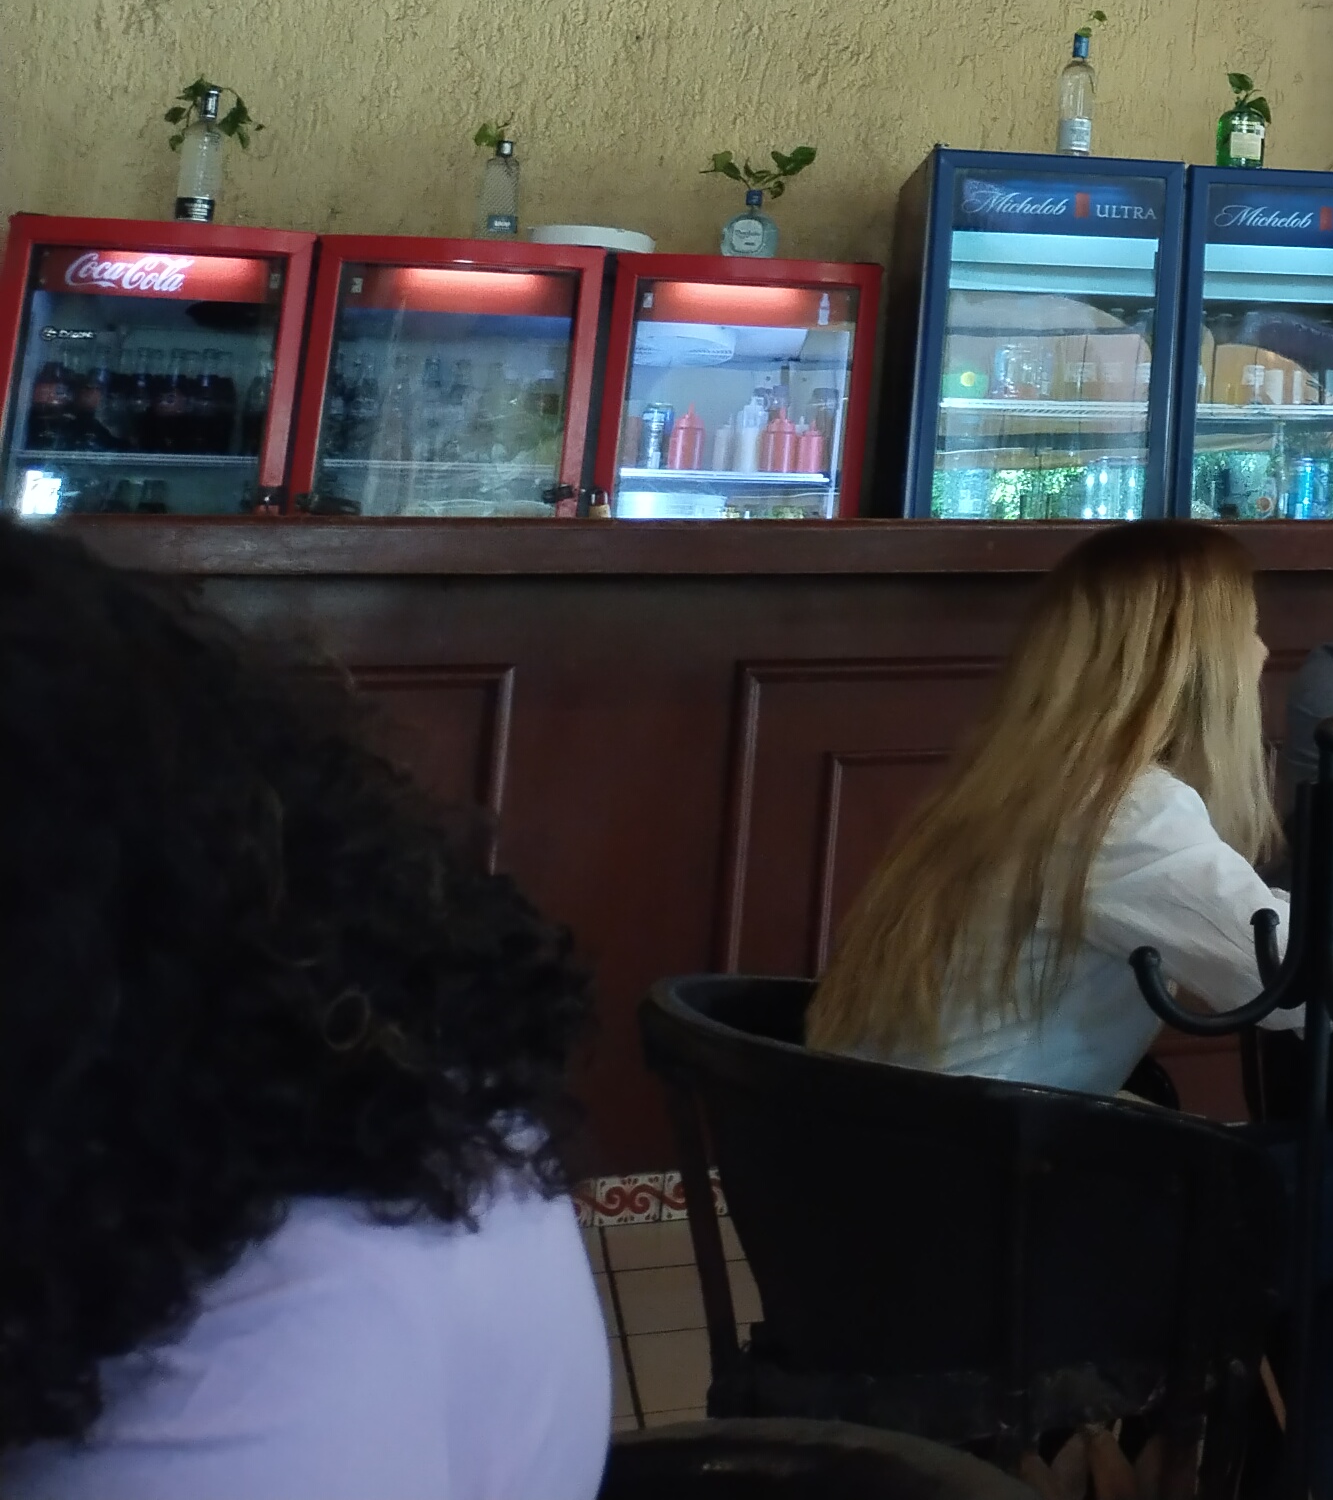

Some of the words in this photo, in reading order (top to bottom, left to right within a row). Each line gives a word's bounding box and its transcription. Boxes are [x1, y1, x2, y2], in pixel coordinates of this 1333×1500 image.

[961, 191, 1070, 215] Michelob
[1096, 204, 1157, 220] ULTRA
[1214, 204, 1315, 228] Michelob
[64, 252, 194, 292] Coca-Cola
